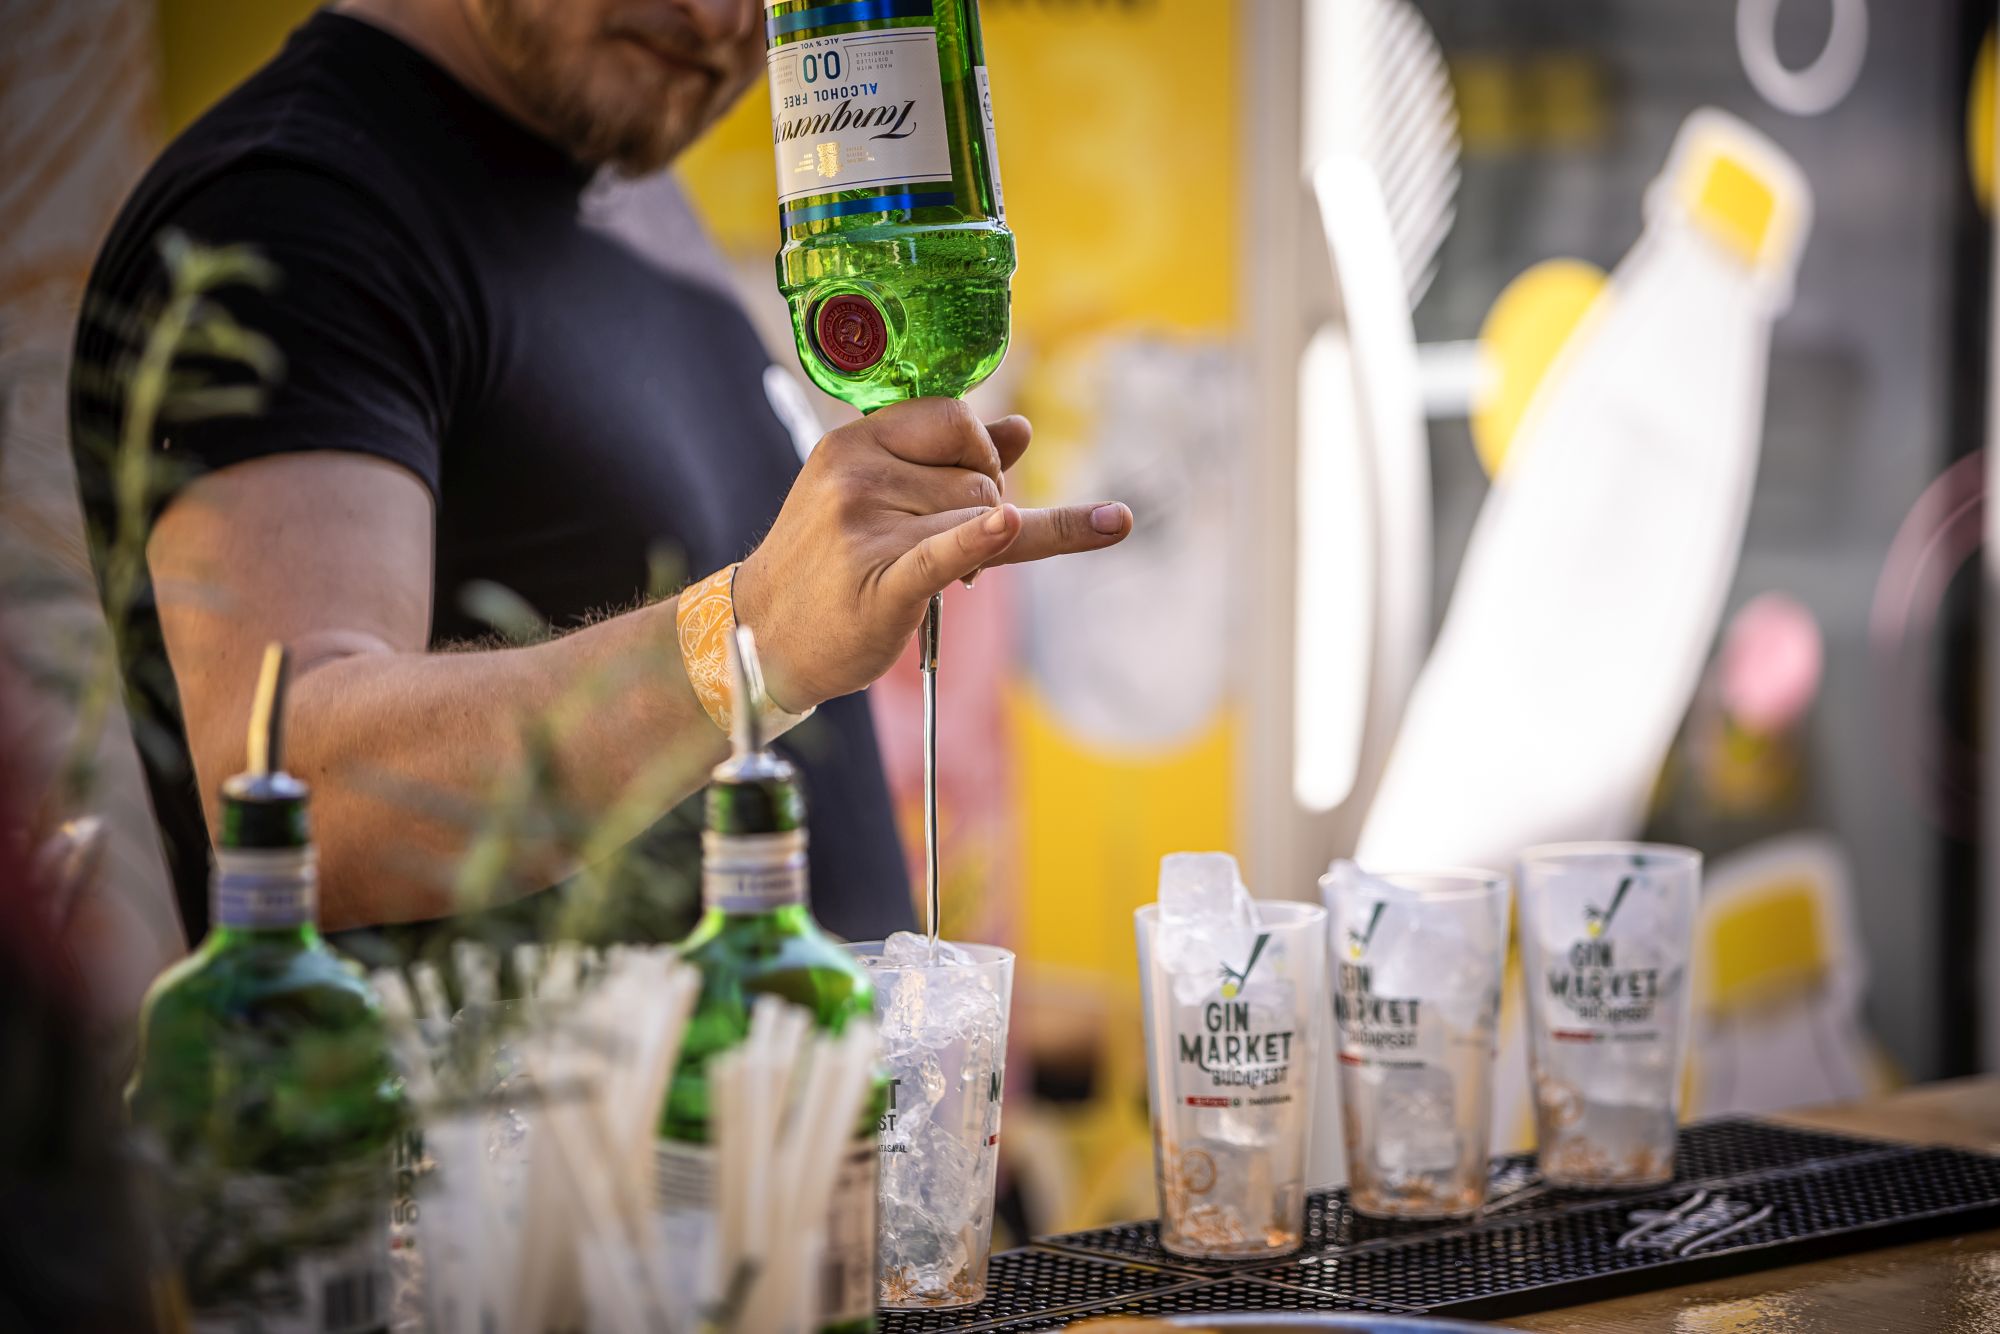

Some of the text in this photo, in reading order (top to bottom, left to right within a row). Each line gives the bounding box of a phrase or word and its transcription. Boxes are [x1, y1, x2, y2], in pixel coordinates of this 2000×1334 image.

[800, 37, 840, 50] ALC % VOL
[802, 50, 841, 84] 0.0
[783, 81, 878, 109] ALCOHOL FREE
[773, 98, 917, 145] Tanqueray
[1206, 1002, 1250, 1033] GIN
[1178, 1030, 1295, 1072] MARKET
